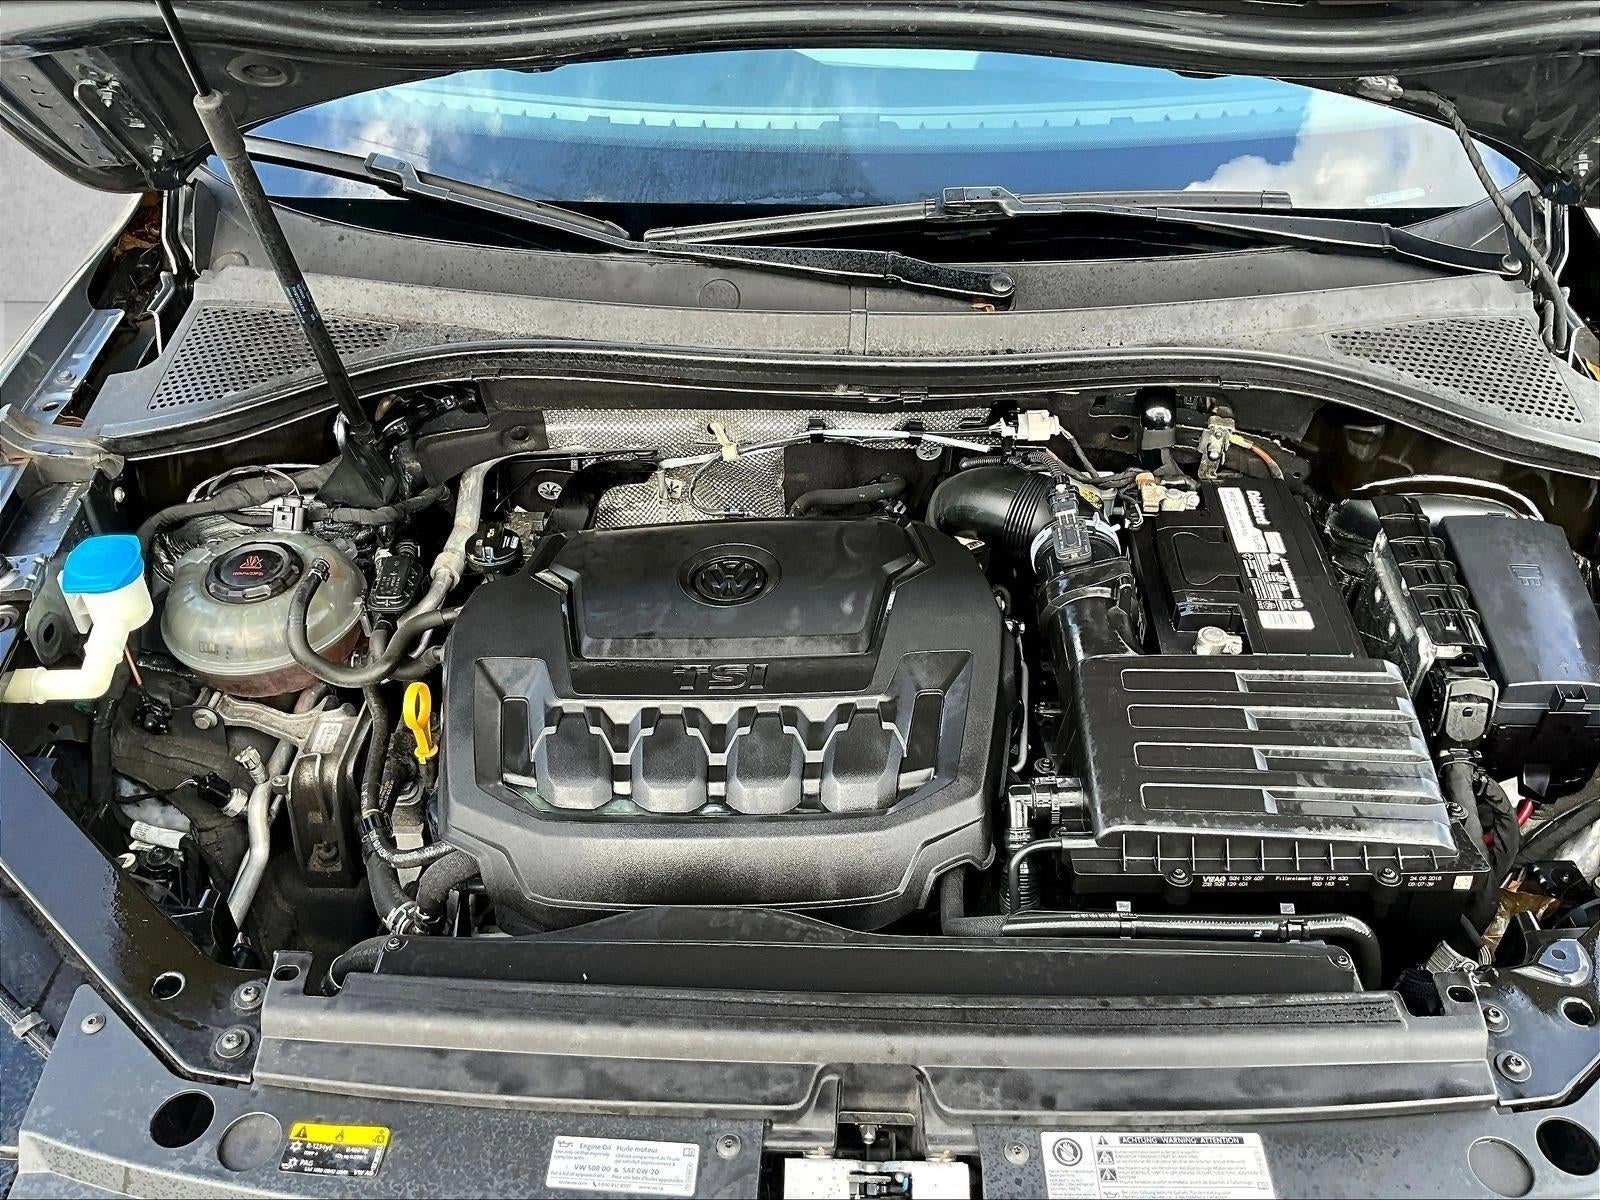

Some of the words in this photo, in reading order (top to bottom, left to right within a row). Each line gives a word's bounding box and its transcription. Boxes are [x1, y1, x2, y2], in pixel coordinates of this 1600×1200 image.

[672, 663, 768, 690] TSI
[1122, 1136, 1158, 1144] ACHTUNG
[1160, 1136, 1197, 1144] WARNING
[1200, 1136, 1240, 1144] ATTENTION
[580, 1143, 601, 1151] Engine
[601, 1165, 611, 1173] 00
[622, 1166, 635, 1174] SAE
